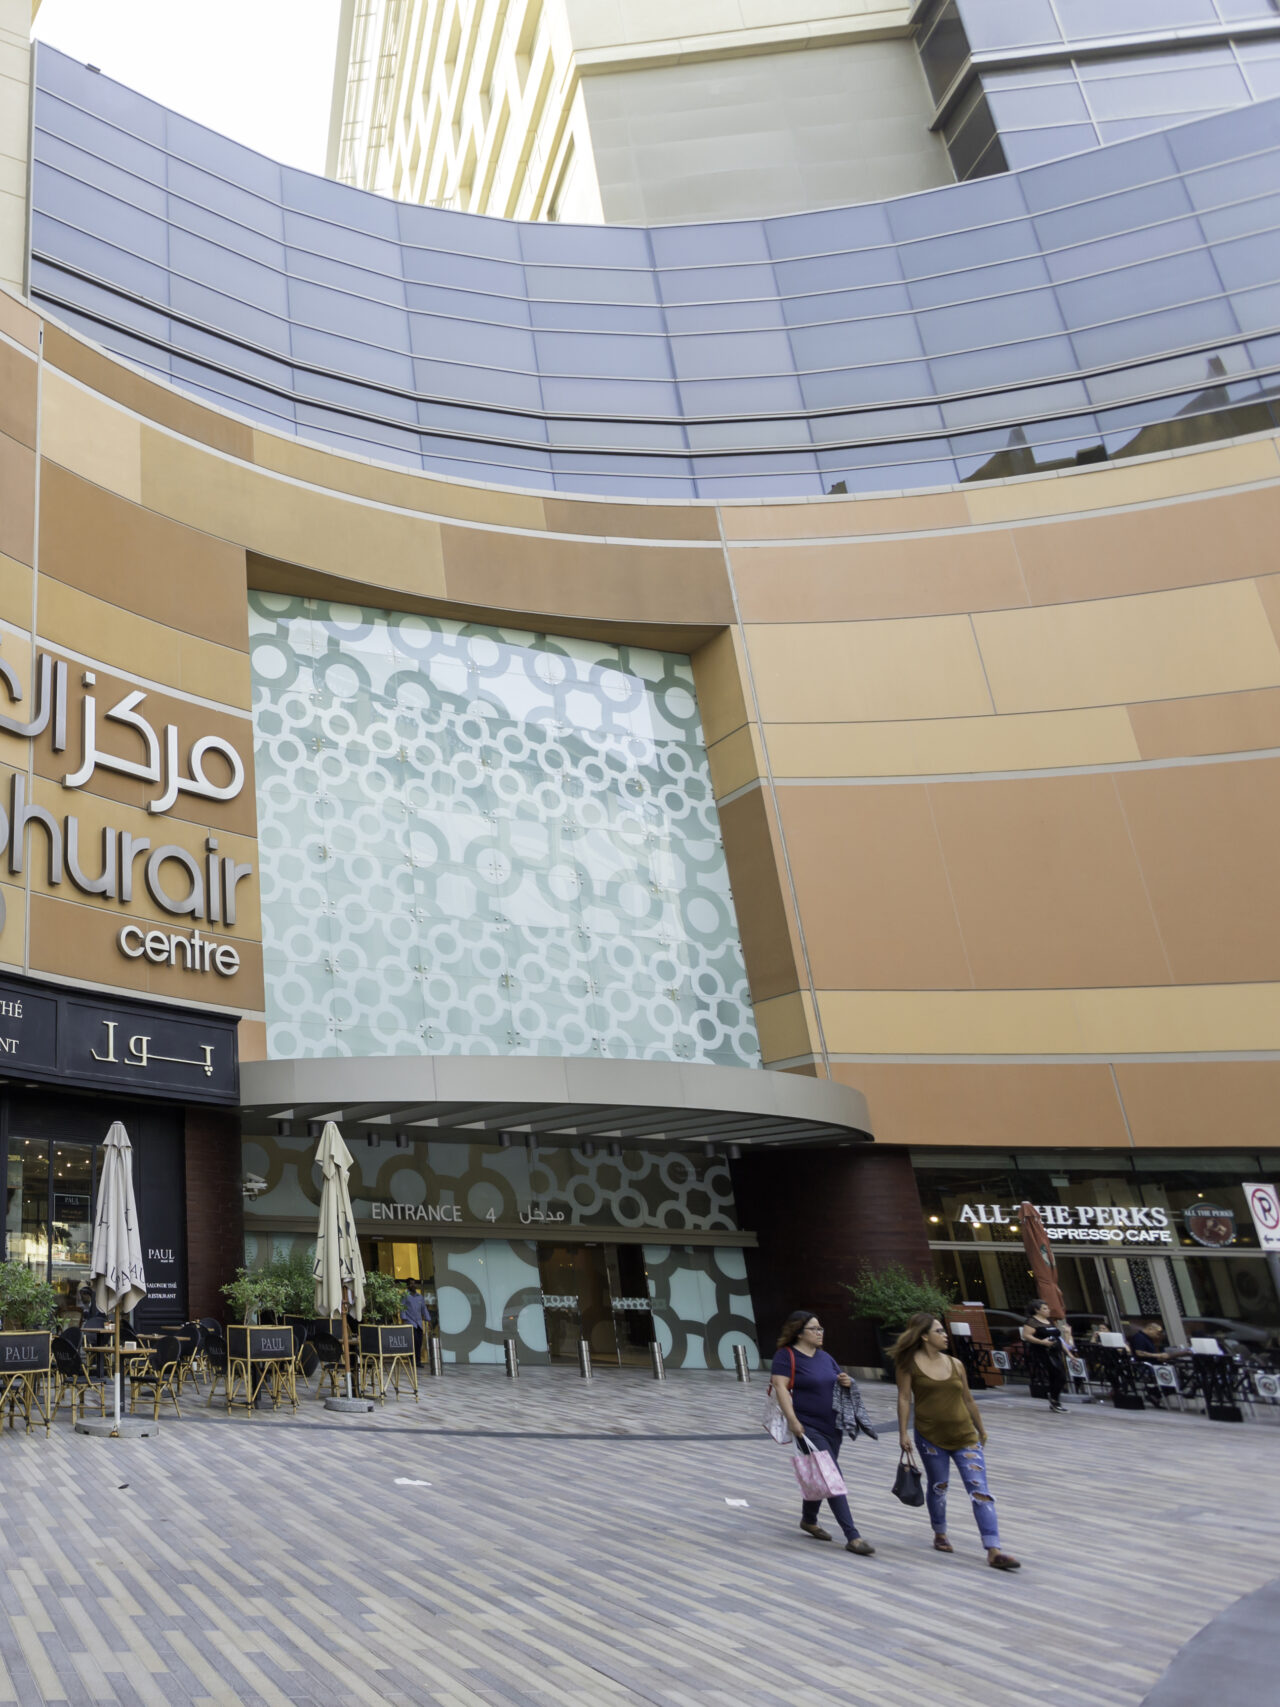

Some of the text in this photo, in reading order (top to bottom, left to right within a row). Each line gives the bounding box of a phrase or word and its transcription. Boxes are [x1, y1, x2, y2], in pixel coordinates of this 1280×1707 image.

[62, 671, 245, 814] مركز
[116, 923, 241, 977] centre
[371, 1202, 497, 1223] ENTRANCE 4
[519, 1205, 565, 1224] مدخل
[959, 1204, 1169, 1227] ALL HE PERKS
[1043, 1227, 1122, 1241] SPRESSO
[1125, 1229, 1173, 1242] CAFE
[148, 1248, 175, 1260] PAUL
[261, 1337, 285, 1350] PAUL
[389, 1335, 408, 1347] PAUL
[5, 1346, 39, 1361] PAUL
